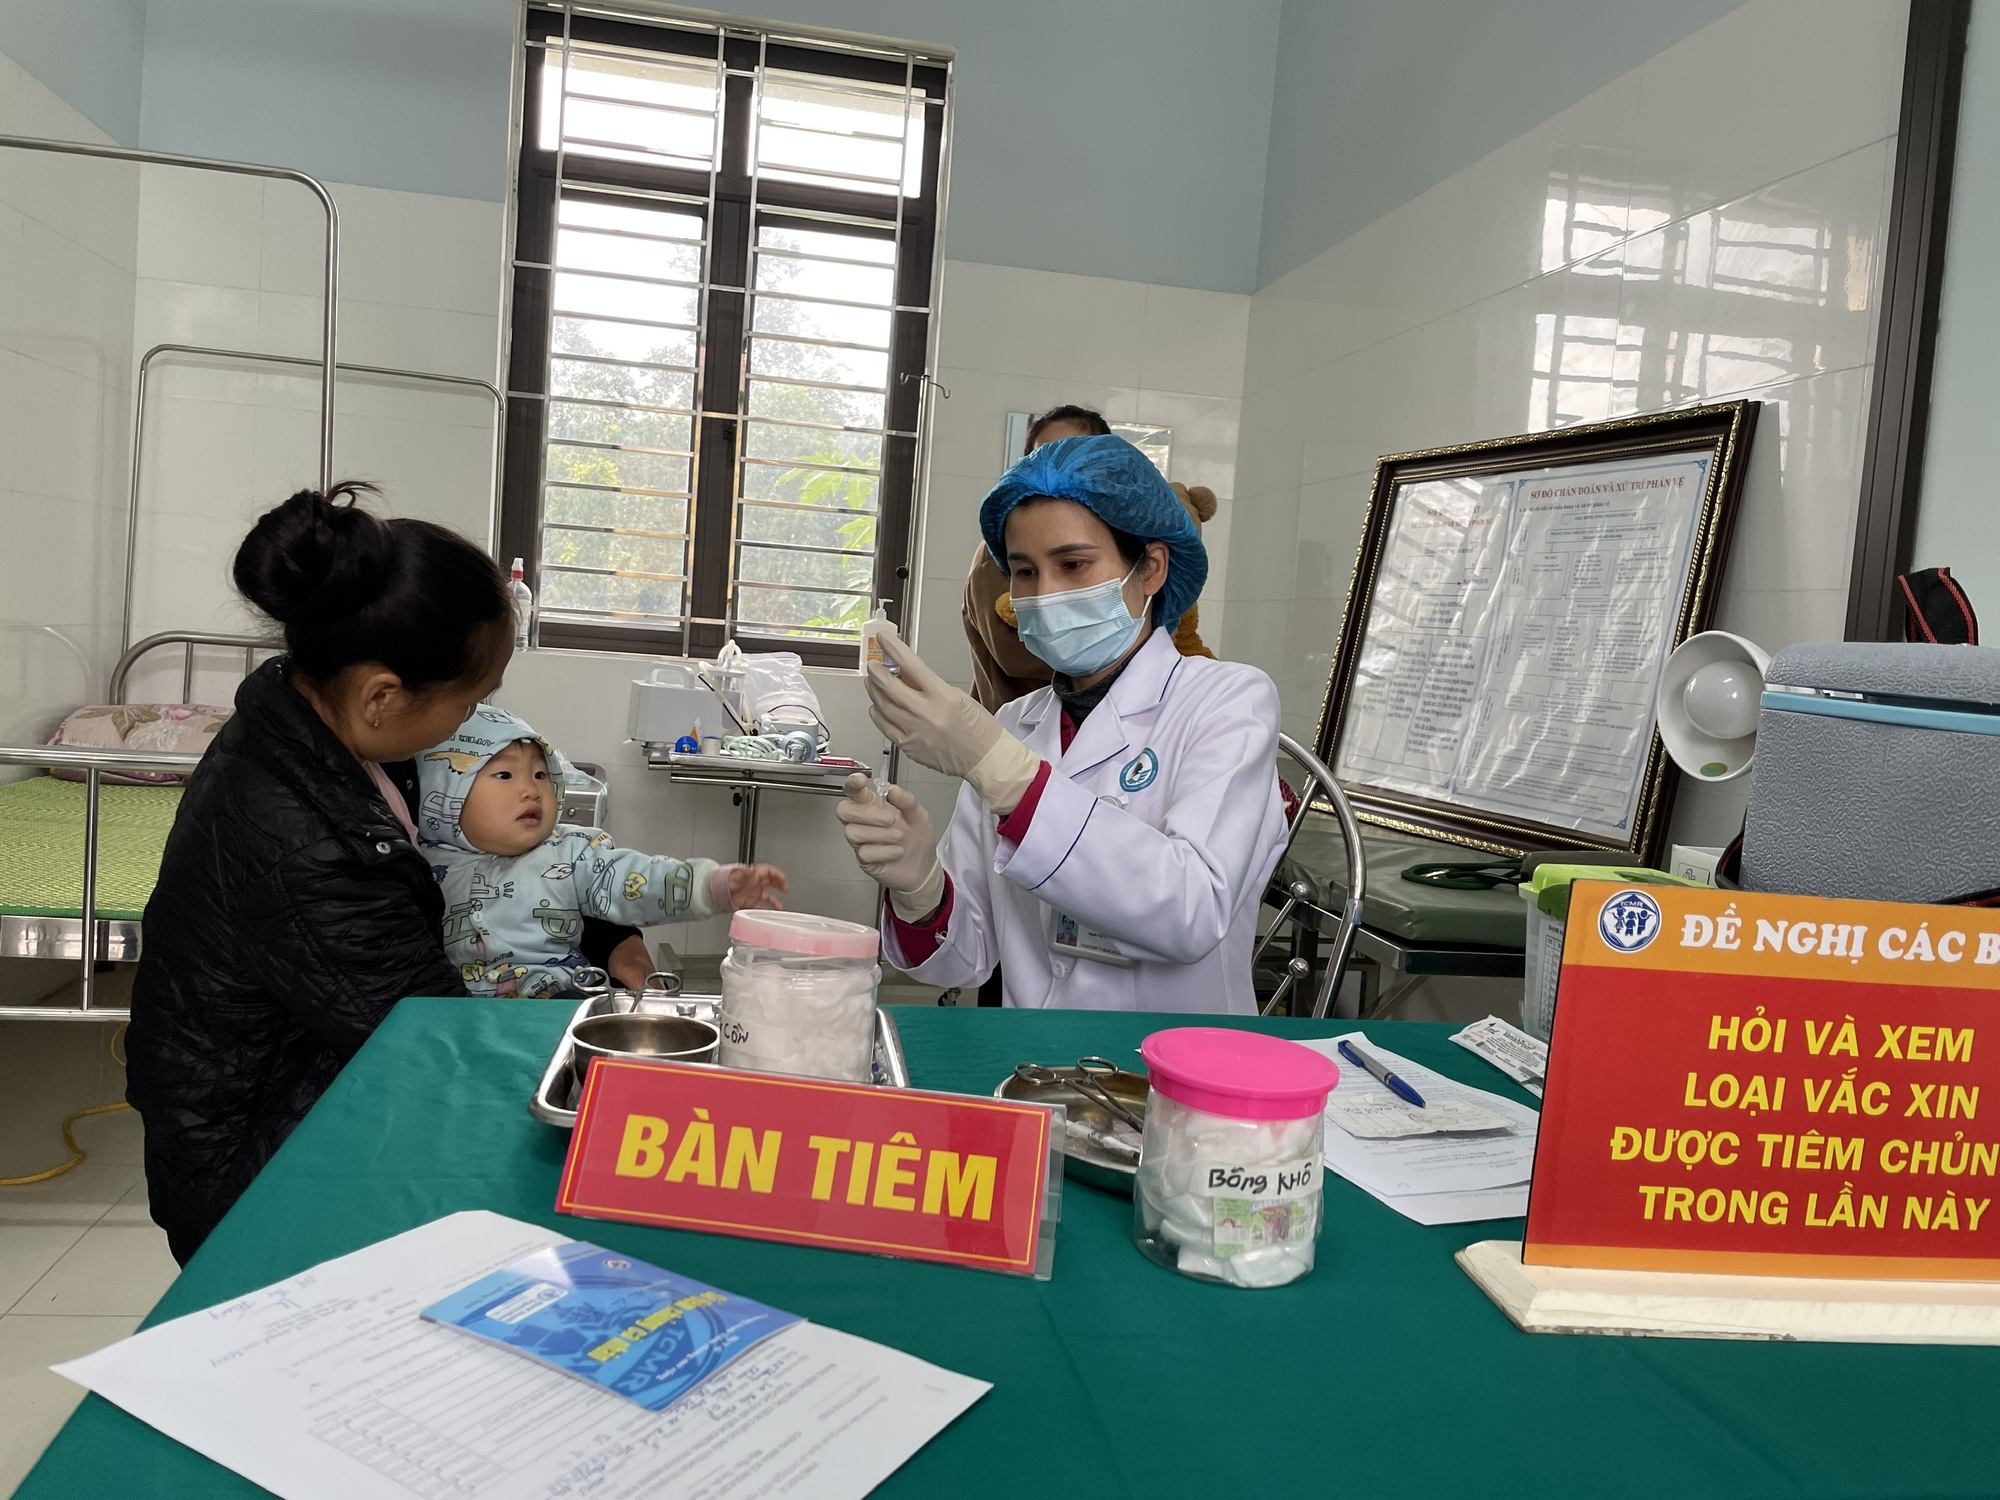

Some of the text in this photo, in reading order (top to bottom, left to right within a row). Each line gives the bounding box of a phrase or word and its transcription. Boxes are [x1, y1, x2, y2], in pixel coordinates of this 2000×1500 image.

[1602, 482, 1615, 493] VÀ
[1680, 902, 1742, 950] ĐỀ
[1753, 919, 1868, 965] NGHỊ
[1877, 921, 1966, 963] CÁC
[1709, 1006, 1975, 1062] HỎI VÀ XEM
[1684, 1068, 1979, 1119] LOẠI VẮC XIN
[615, 1108, 998, 1221] BÀN TIÊM
[1610, 1126, 1740, 1169] ĐƯỢC
[1757, 1129, 1865, 1171] TIÊM
[1639, 1182, 1991, 1230] TRONG LẦN NÀY
[617, 1327, 686, 1392] TCMR
